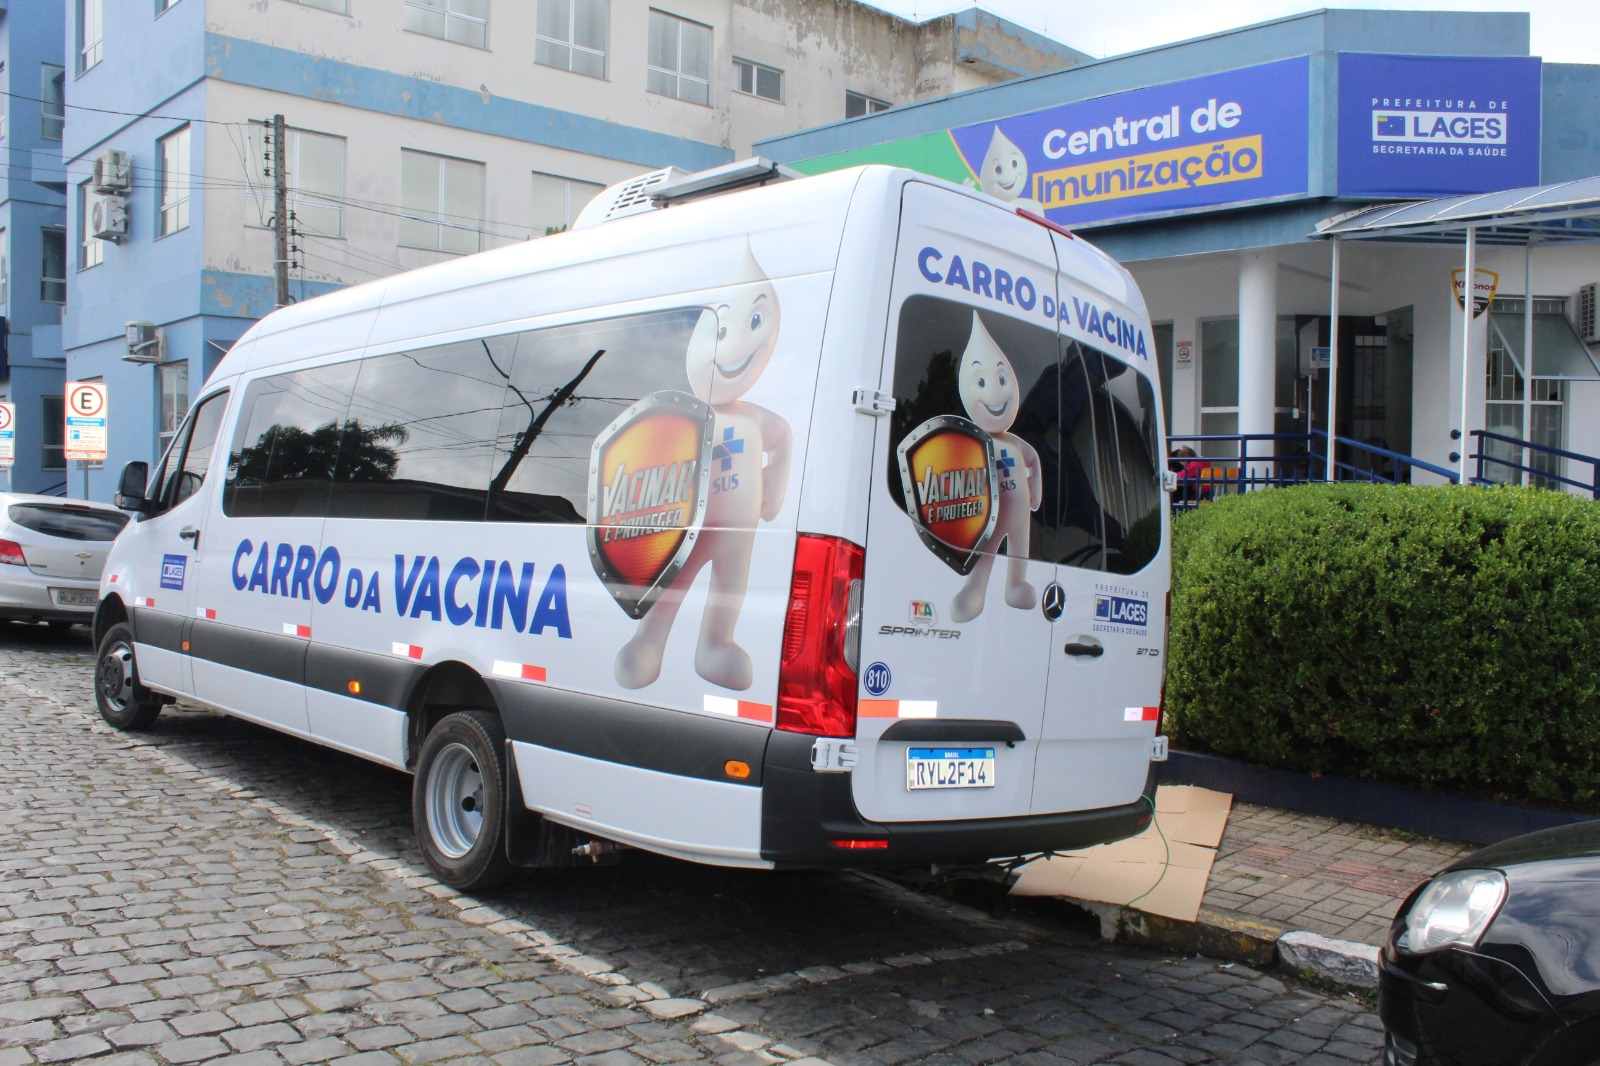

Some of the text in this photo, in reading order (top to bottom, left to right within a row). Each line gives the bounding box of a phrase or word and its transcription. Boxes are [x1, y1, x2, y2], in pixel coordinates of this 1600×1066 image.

[1372, 98, 1507, 109] PREFEITURA DE
[1042, 98, 1242, 160] Central de
[1413, 116, 1502, 139] LAGES
[1372, 145, 1507, 156] SECRETARIA DA SAÚDE
[1037, 143, 1258, 206] Imunização
[917, 246, 1148, 361] CARRO DA VACINA
[81, 392, 92, 409] E
[602, 459, 697, 518] VACINAR
[712, 473, 740, 495] SUS
[916, 465, 987, 506] VACINAR
[1000, 479, 1017, 492] SUS
[936, 499, 985, 522] PROTEGER
[231, 538, 573, 639] CARRO DA VACINA
[1095, 583, 1138, 596] PREFEITURA
[912, 601, 932, 617] TCA
[1111, 600, 1147, 623] LAGES
[878, 625, 961, 639] SPRINTER
[1093, 624, 1125, 633] SECRETARIA
[1126, 627, 1132, 635] DE
[868, 669, 888, 689] 810
[916, 761, 986, 786] RYL2F14
